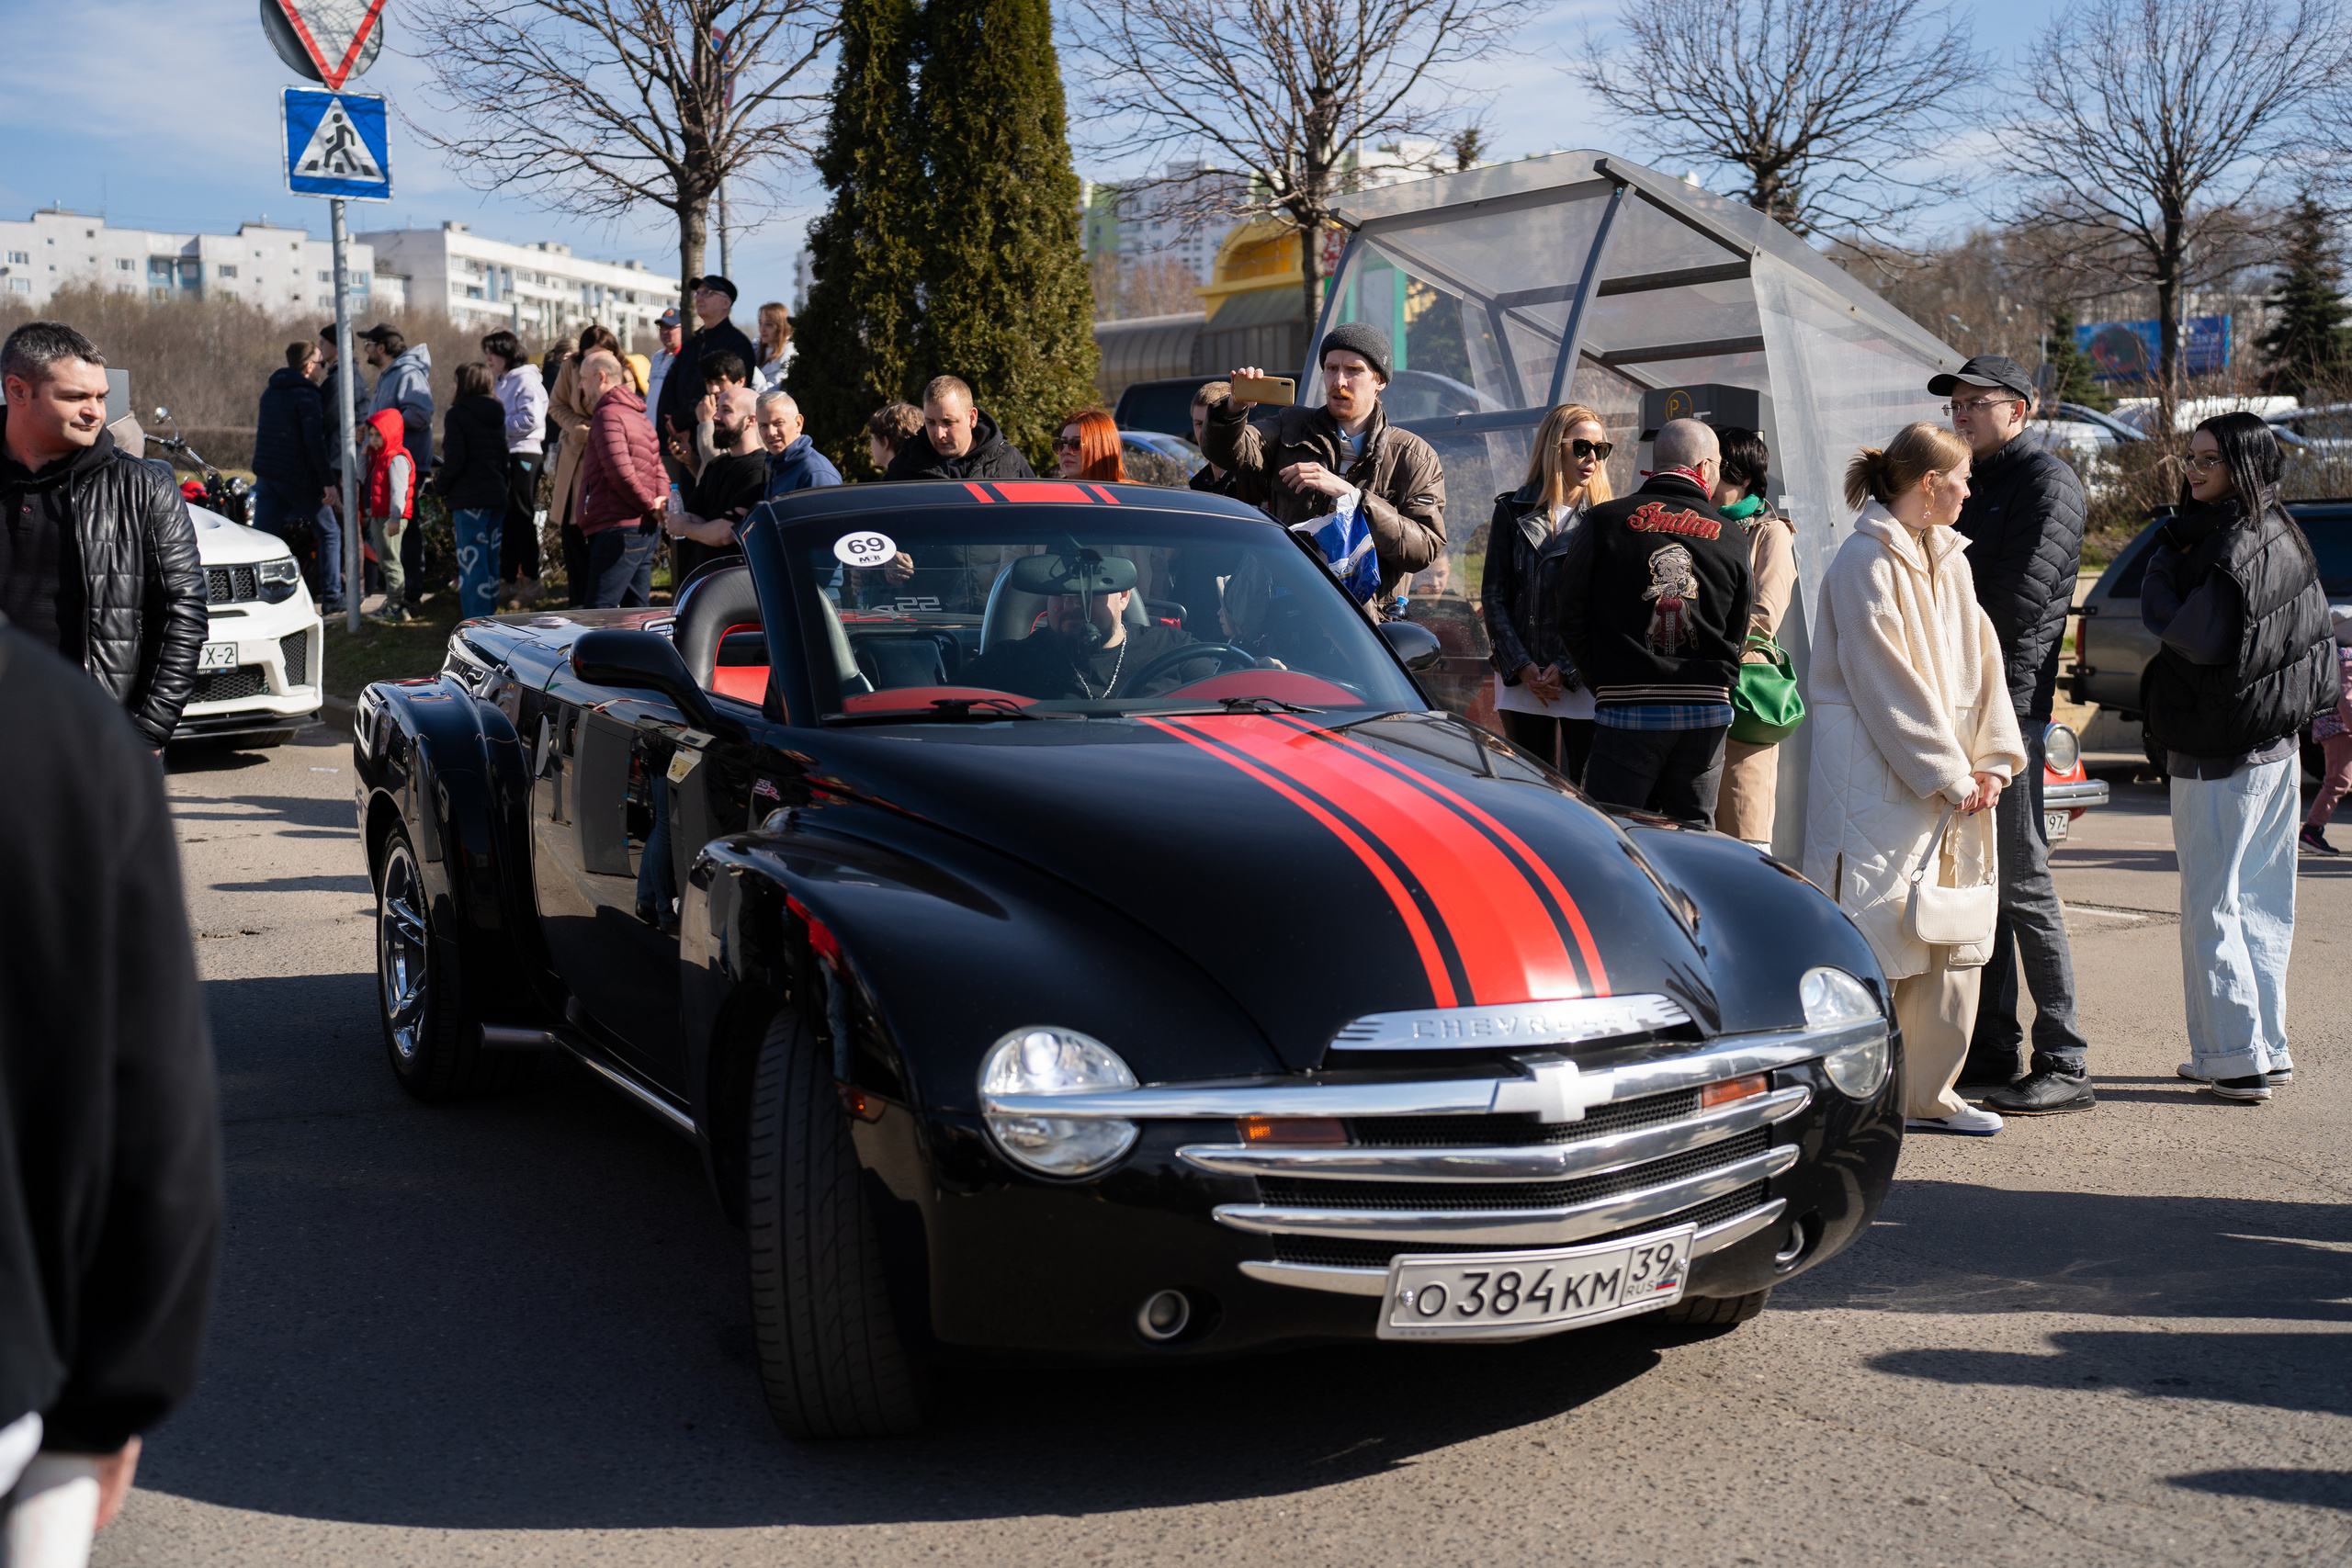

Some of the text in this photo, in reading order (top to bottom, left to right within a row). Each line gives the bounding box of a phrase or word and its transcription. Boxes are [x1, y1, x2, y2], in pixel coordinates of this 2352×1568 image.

[1626, 502, 1723, 540] Indian
[847, 536, 886, 554] 69
[201, 647, 234, 665] X-2
[2049, 816, 2064, 830] 97
[1632, 1243, 1674, 1282] 39
[1626, 1279, 1655, 1296] RUS
